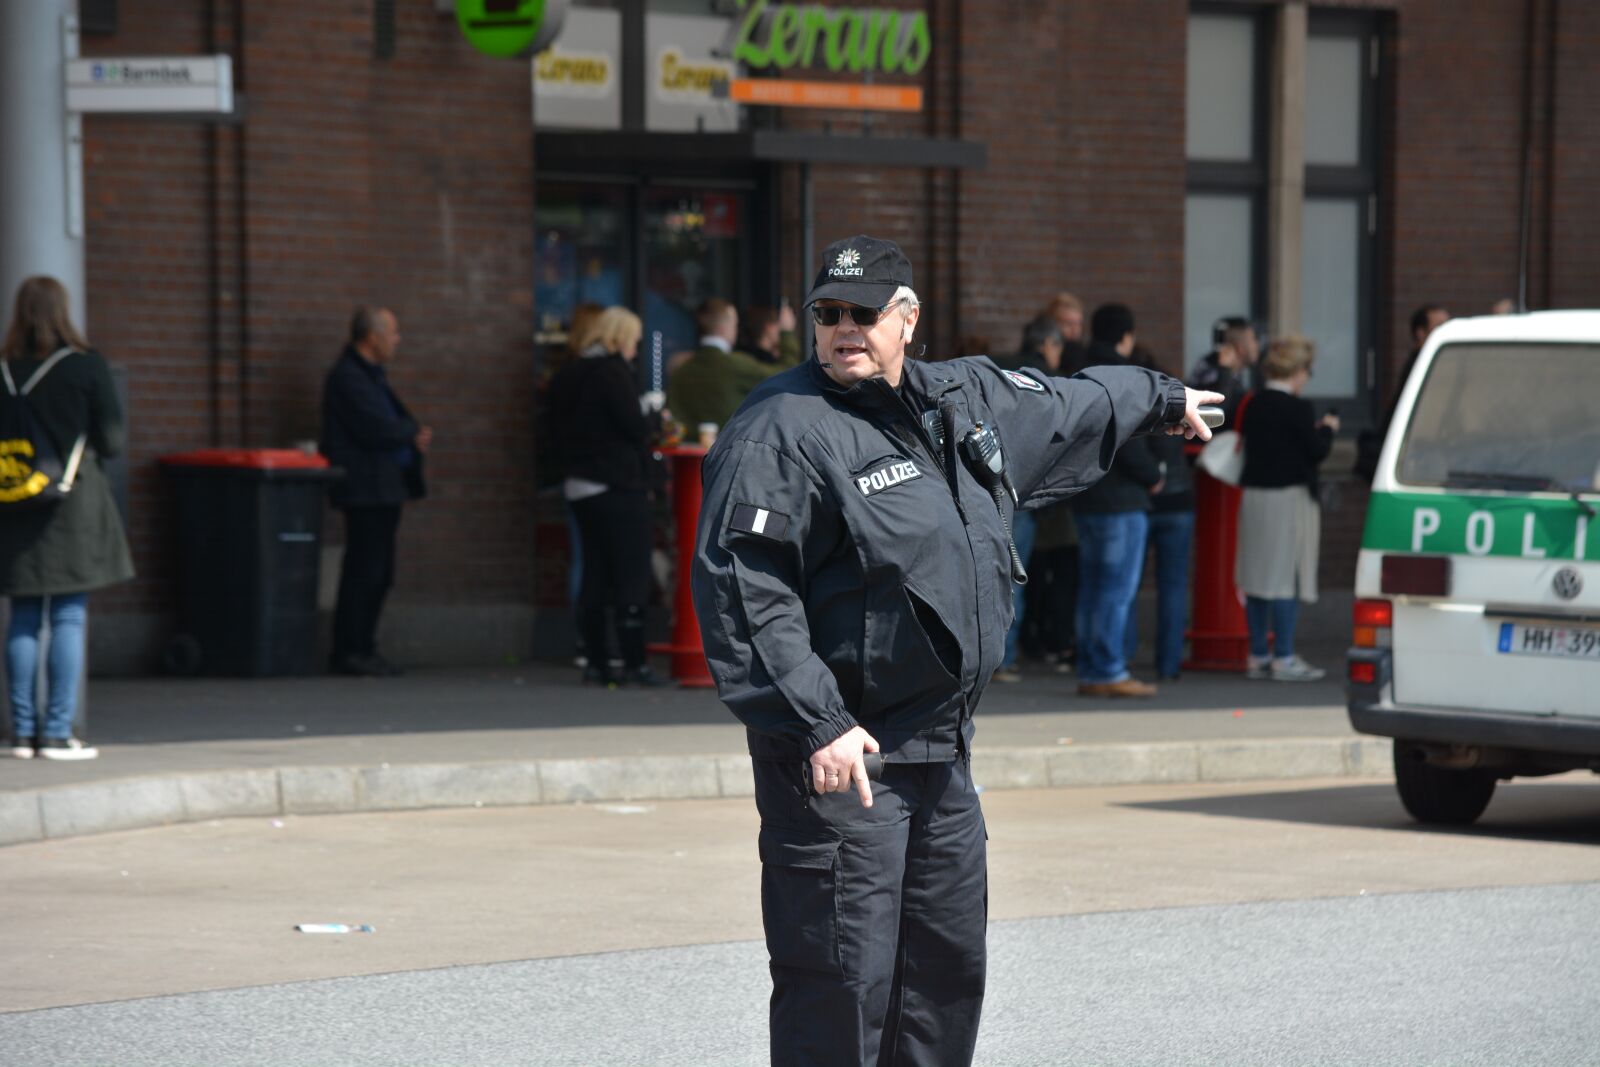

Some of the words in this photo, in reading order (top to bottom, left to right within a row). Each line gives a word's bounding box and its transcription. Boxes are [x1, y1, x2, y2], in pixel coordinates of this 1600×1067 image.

[733, 0, 931, 75] Zerans
[828, 267, 864, 277] POLIZEI
[857, 460, 921, 496] POLIZEI
[1567, 631, 1600, 655] 39
